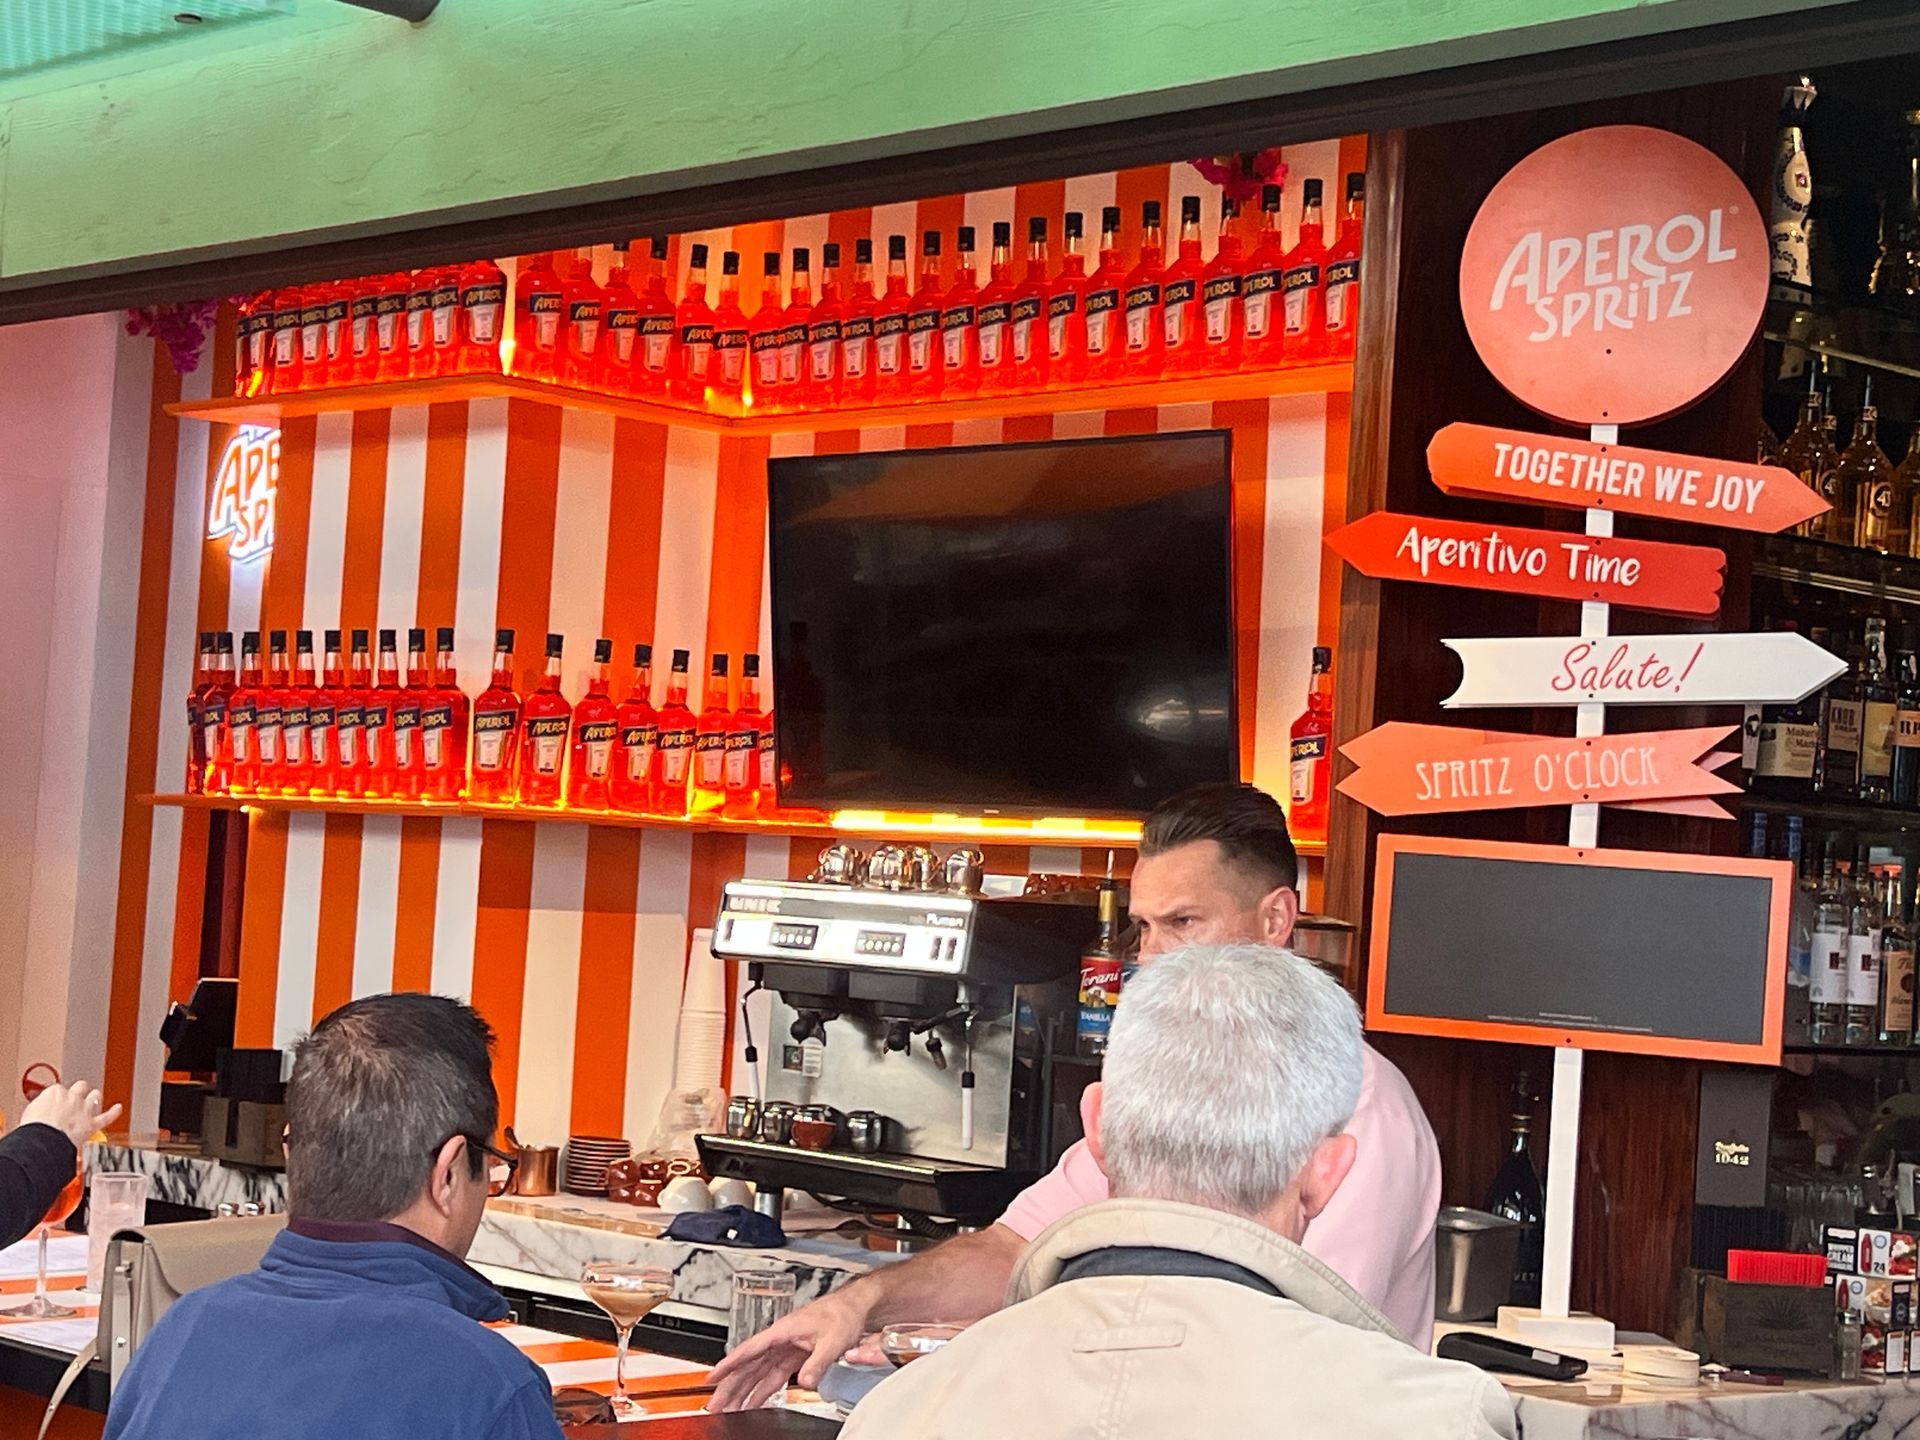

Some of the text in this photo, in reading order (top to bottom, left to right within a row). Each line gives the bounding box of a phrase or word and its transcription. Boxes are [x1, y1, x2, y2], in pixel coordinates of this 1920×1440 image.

[1489, 208, 1737, 311] APEROL
[1494, 442, 1766, 514] TOGETHER WE JOY
[1396, 526, 1641, 586] Aperitivo Time
[1551, 642, 1704, 693] Salute!
[1415, 746, 1660, 801] SPRITZ O'CLOCK
[1080, 966, 1120, 992] Torani
